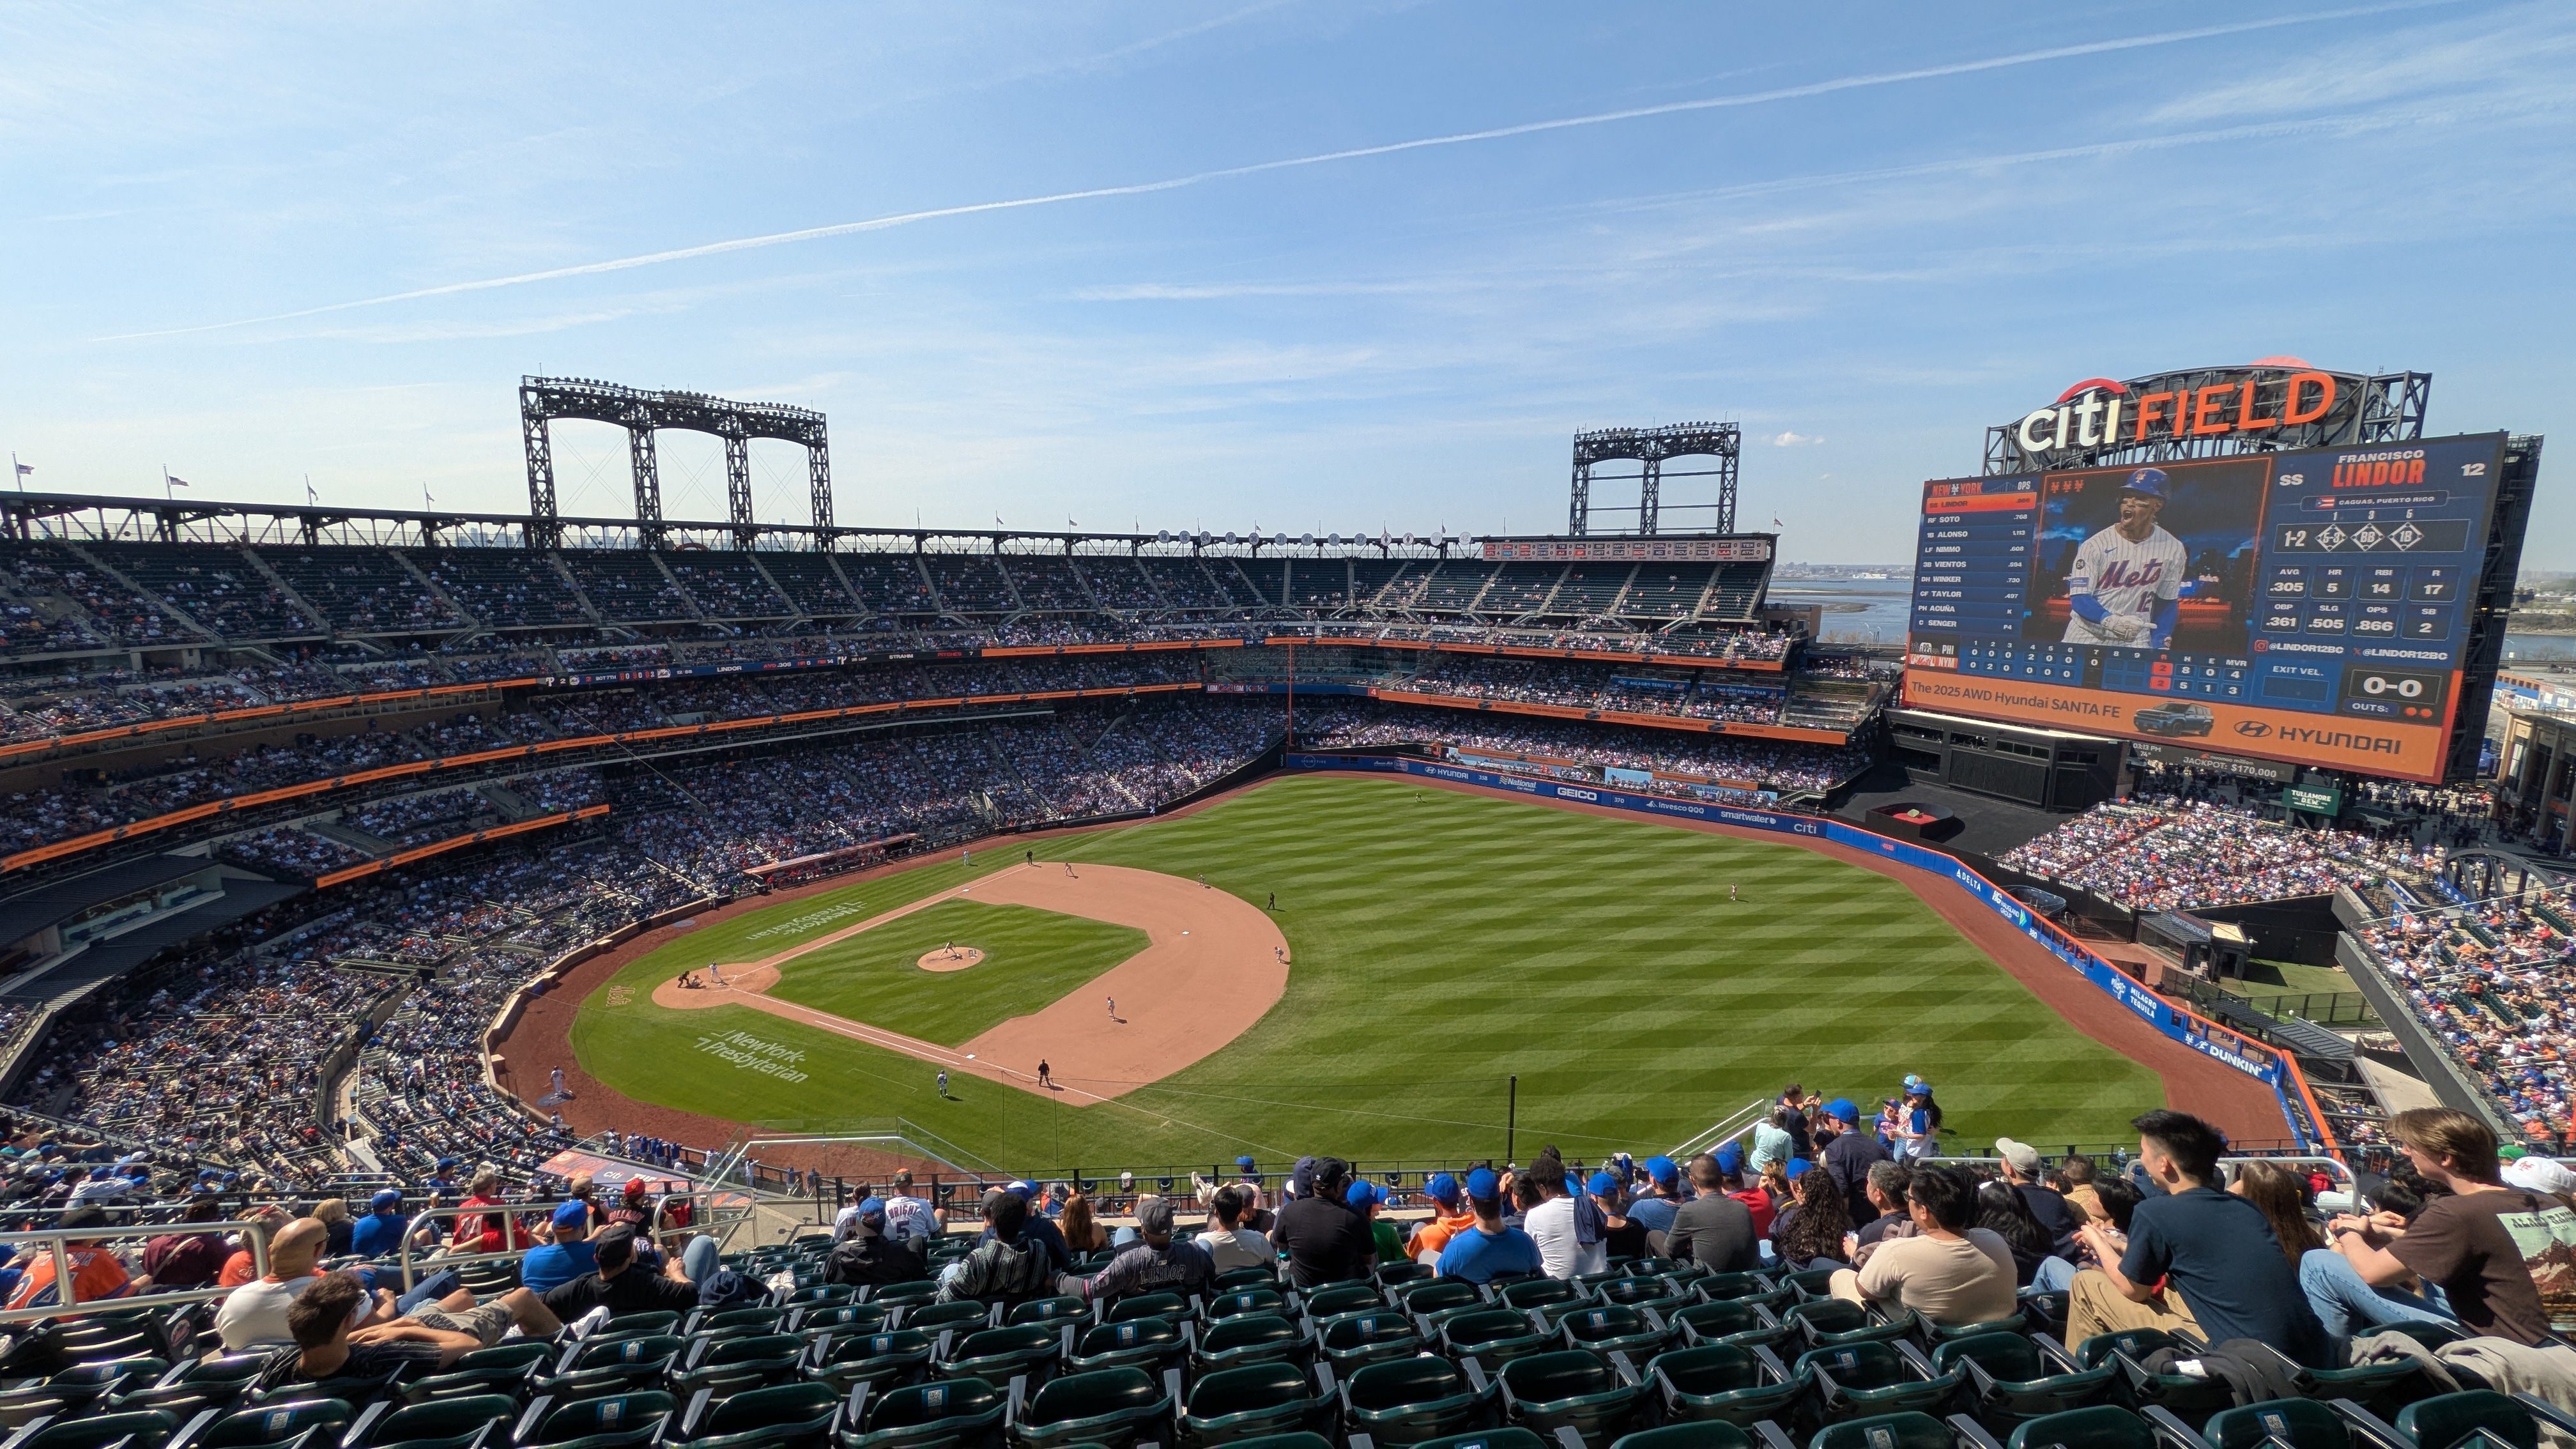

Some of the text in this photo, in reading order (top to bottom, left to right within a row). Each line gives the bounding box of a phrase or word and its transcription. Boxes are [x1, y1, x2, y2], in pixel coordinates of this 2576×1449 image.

[2020, 372, 2336, 452] citi FIELD
[2338, 450, 2425, 463] FRANCISCO
[2333, 460, 2425, 487] LINDOR
[2460, 463, 2485, 477] 12
[2018, 481, 2030, 490] OPS
[2280, 474, 2303, 486] SS
[1933, 482, 1982, 496] NEW YORK
[2333, 512, 2338, 521] 1
[2368, 510, 2375, 519] 3
[2285, 530, 2306, 547] 1-2
[2360, 532, 2375, 542] BB
[2400, 531, 2412, 542] 1B
[2096, 558, 2163, 590] Mets
[2270, 582, 2443, 595] .305 5 14 17
[2136, 591, 2154, 612] 12
[2266, 617, 2432, 633] .361 .505 .866 2
[1942, 645, 1954, 655] PHI
[2269, 643, 2343, 654] @LINDOR12BC
[2363, 649, 2448, 661] @LINDOR12BC
[1939, 657, 1954, 668] NYM
[2363, 677, 2423, 697] 0-0
[1912, 681, 2121, 718] The 2025 AWD Hyundai SANTA FE
[2352, 703, 2388, 712] OUTS:
[2279, 726, 2402, 755] HYUNDAI
[1438, 769, 1469, 779] HYUNDAI
[2183, 756, 2277, 778] JACKPOT: $170,000
[1508, 778, 1537, 788] National
[1557, 786, 1597, 801] GEICO
[2291, 790, 2331, 802] TULLAMORE
[1659, 802, 1705, 815] Invesco QQQ
[1721, 811, 1769, 824] smartwater
[1794, 822, 1817, 834] citi
[1997, 862, 2020, 873] HubSpot
[1962, 872, 1981, 892] DELTA
[2026, 871, 2050, 882] HubSpot
[2058, 880, 2084, 892] HubSpot
[2131, 987, 2157, 1009] MILAGRO
[2130, 996, 2154, 1018] TEQUILA
[702, 1041, 809, 1083] Presbyterian
[2209, 1045, 2262, 1077] DUNKIN'
[888, 1204, 921, 1220] WRIGHT
[896, 1220, 910, 1239] 5
[1140, 1264, 1186, 1285] LINDOR
